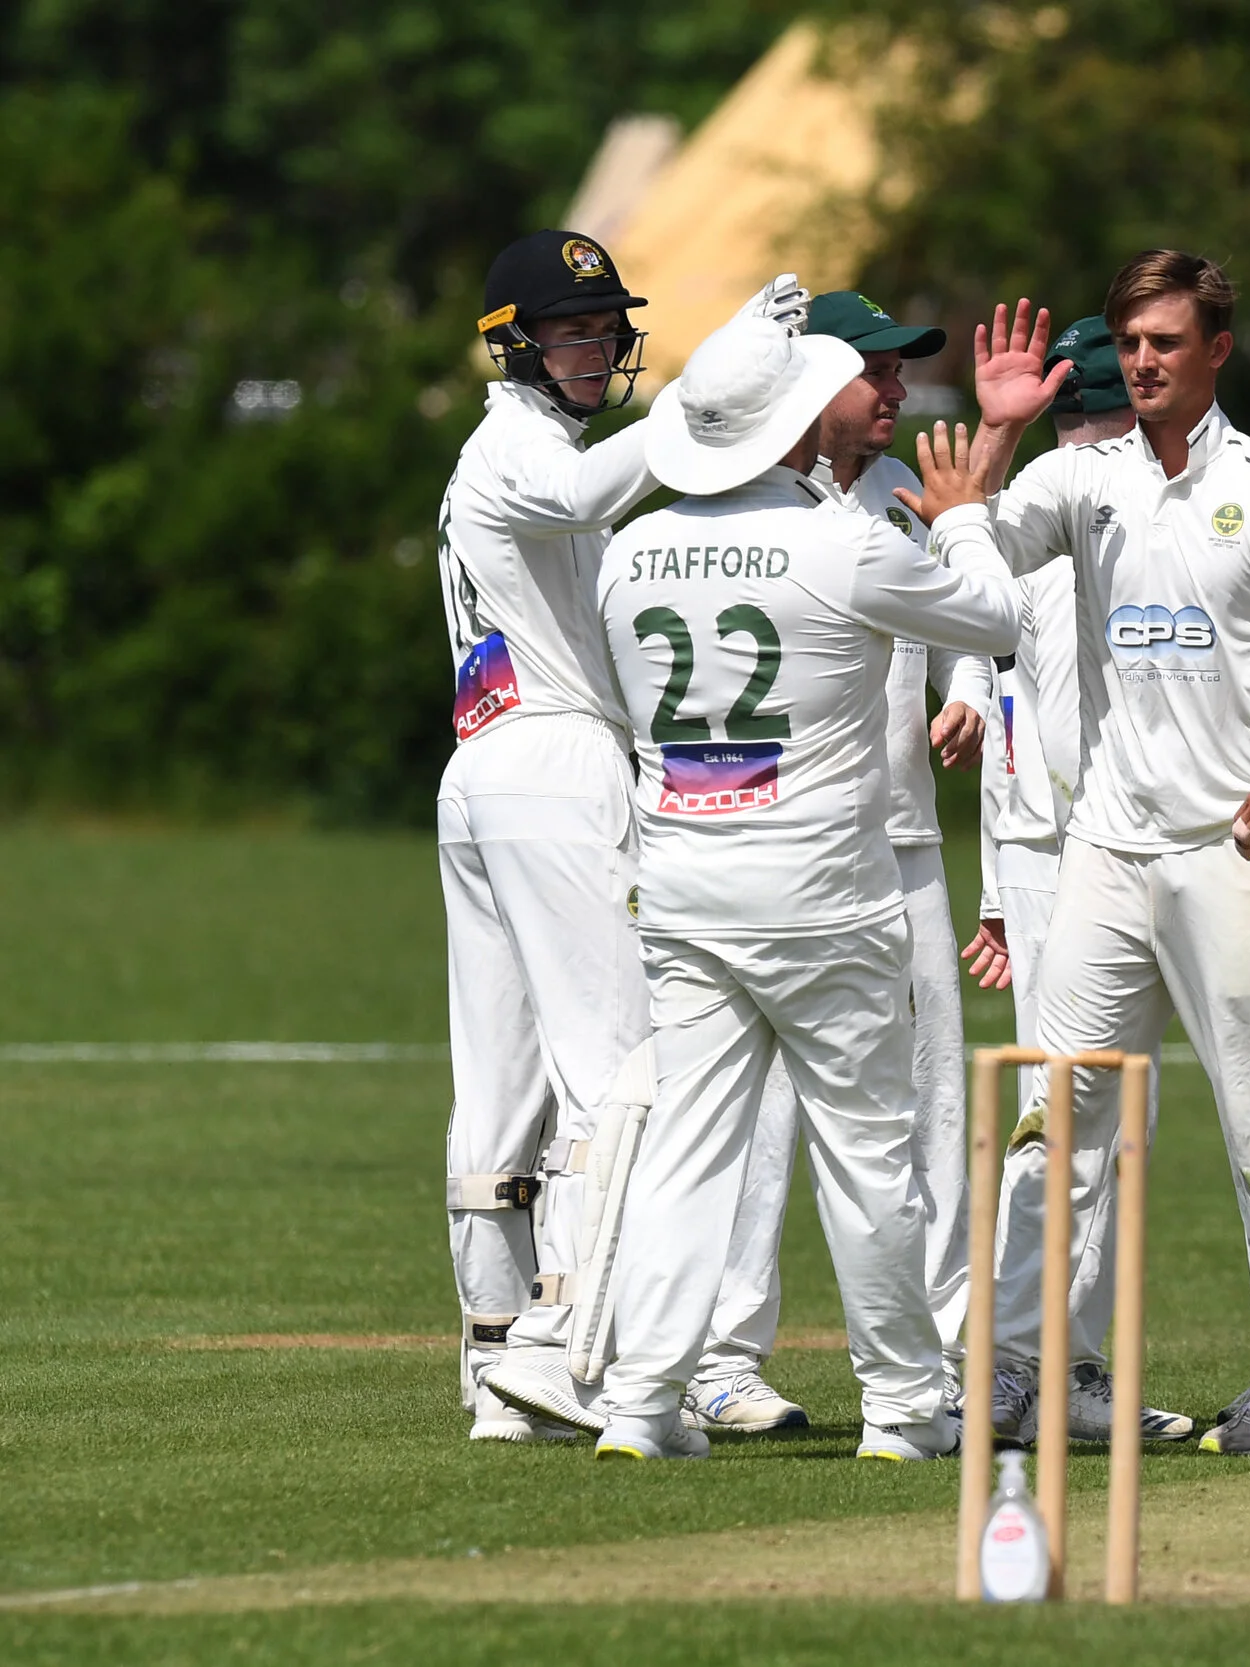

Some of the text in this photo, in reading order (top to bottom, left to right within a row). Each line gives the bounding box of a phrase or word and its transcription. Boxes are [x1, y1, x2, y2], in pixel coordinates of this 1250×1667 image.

[629, 546, 790, 582] STAFFORD
[1111, 621, 1213, 648] CPS
[632, 603, 792, 744] 22
[721, 753, 744, 763] 1964
[660, 784, 774, 812] ADCOCK
